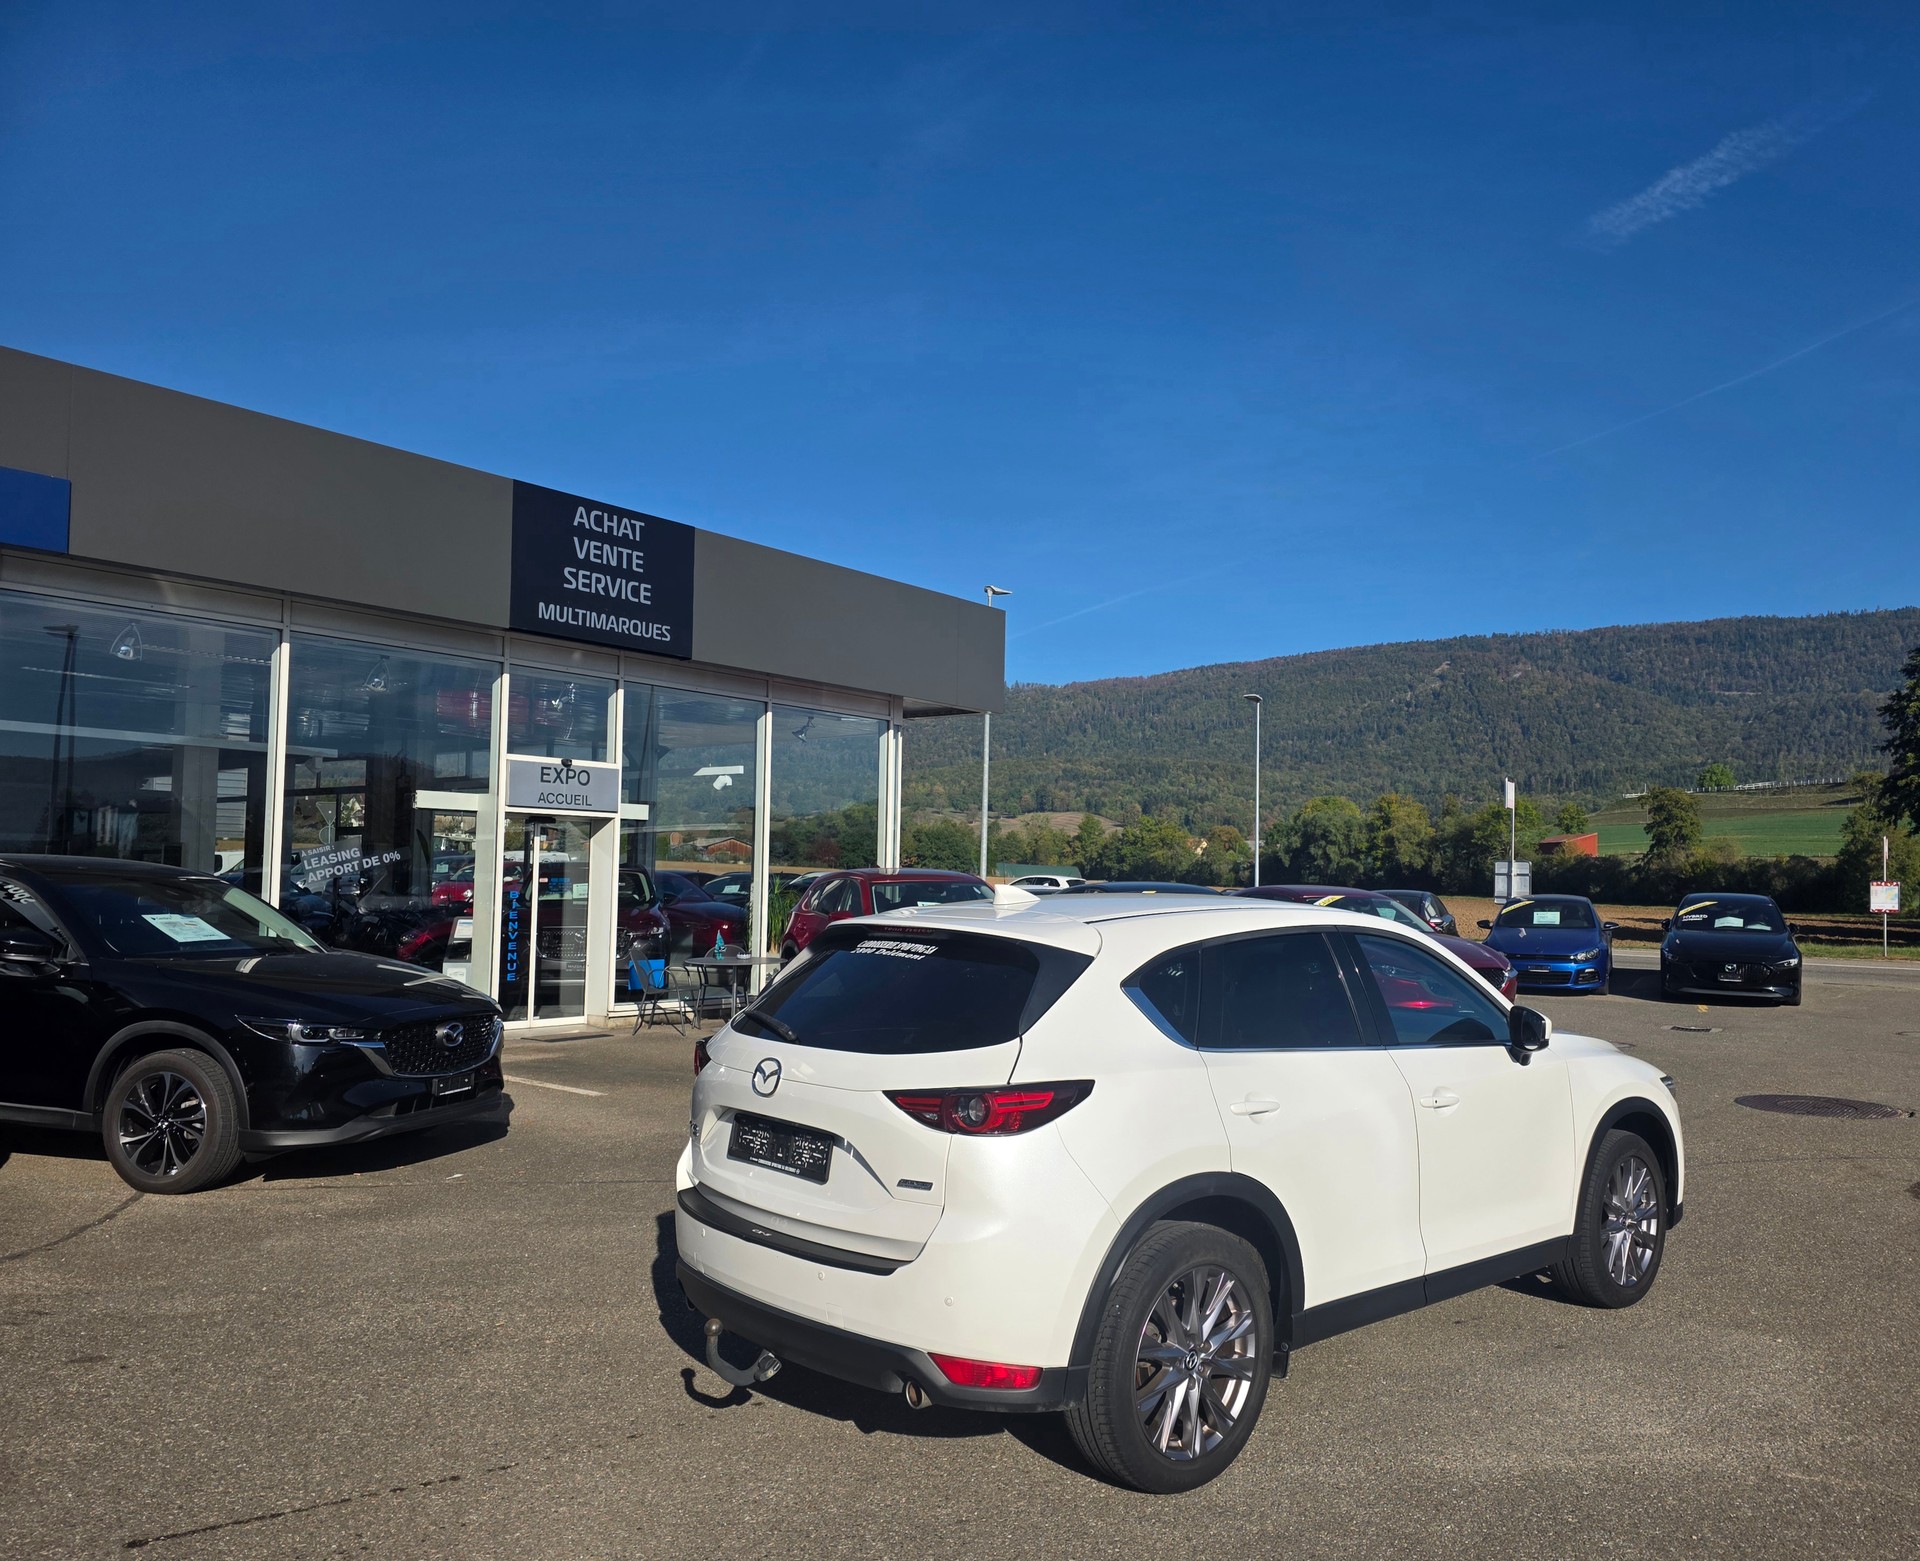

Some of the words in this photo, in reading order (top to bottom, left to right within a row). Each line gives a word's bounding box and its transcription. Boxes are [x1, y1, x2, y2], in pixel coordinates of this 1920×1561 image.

[573, 506, 645, 541] ACHAT
[573, 536, 644, 573] VENTE
[563, 567, 652, 605] SERVICE
[538, 601, 671, 642] MULTIMARQUES
[540, 766, 591, 786] EXPO
[537, 792, 593, 807] ACCUEIL
[303, 847, 361, 870] LEASING
[307, 860, 360, 883] APPORT
[362, 856, 381, 869] DE
[382, 850, 401, 864] 0%
[308, 845, 331, 855] SAISIR
[507, 890, 520, 982] BIENVENUE
